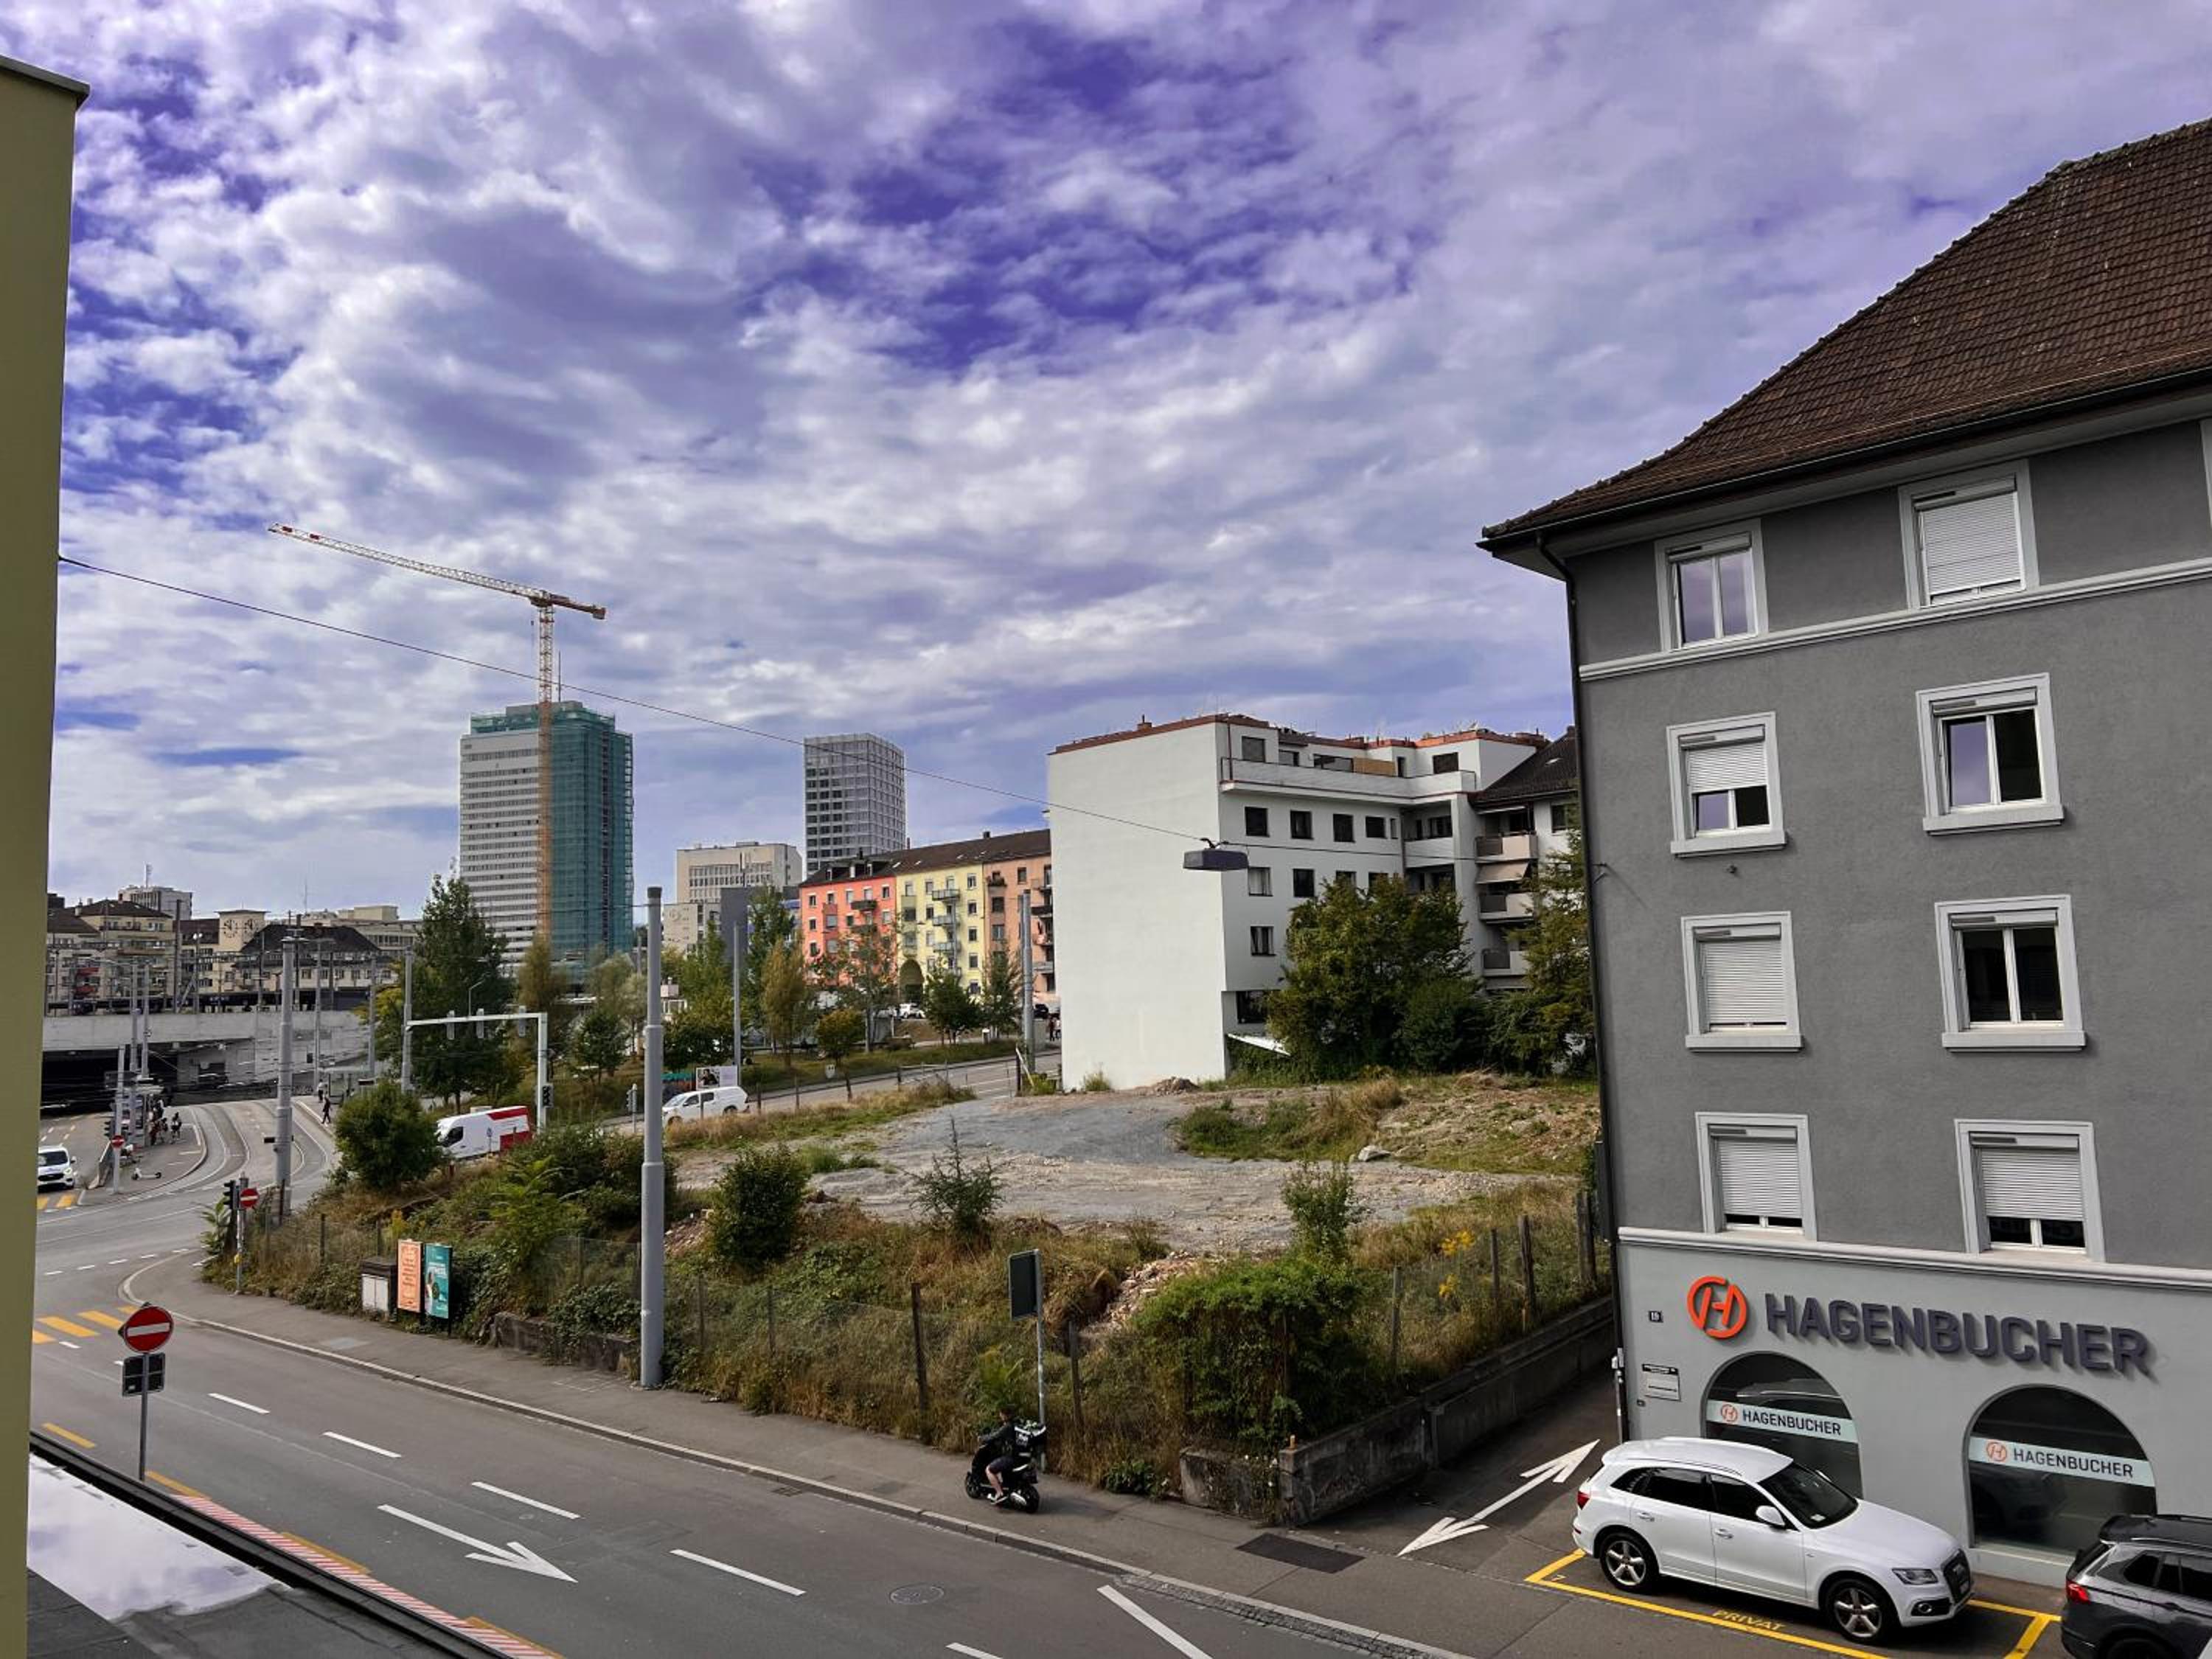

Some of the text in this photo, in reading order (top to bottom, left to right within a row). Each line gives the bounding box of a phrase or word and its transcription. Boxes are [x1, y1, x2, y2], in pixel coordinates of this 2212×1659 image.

[1764, 1293, 2149, 1375] HAGENBUCHER
[1742, 1409, 1842, 1436] HAGENBUCHER
[2014, 1447, 2134, 1478] HAGENBUCHER
[1712, 1610, 1785, 1630] PRIVAT
